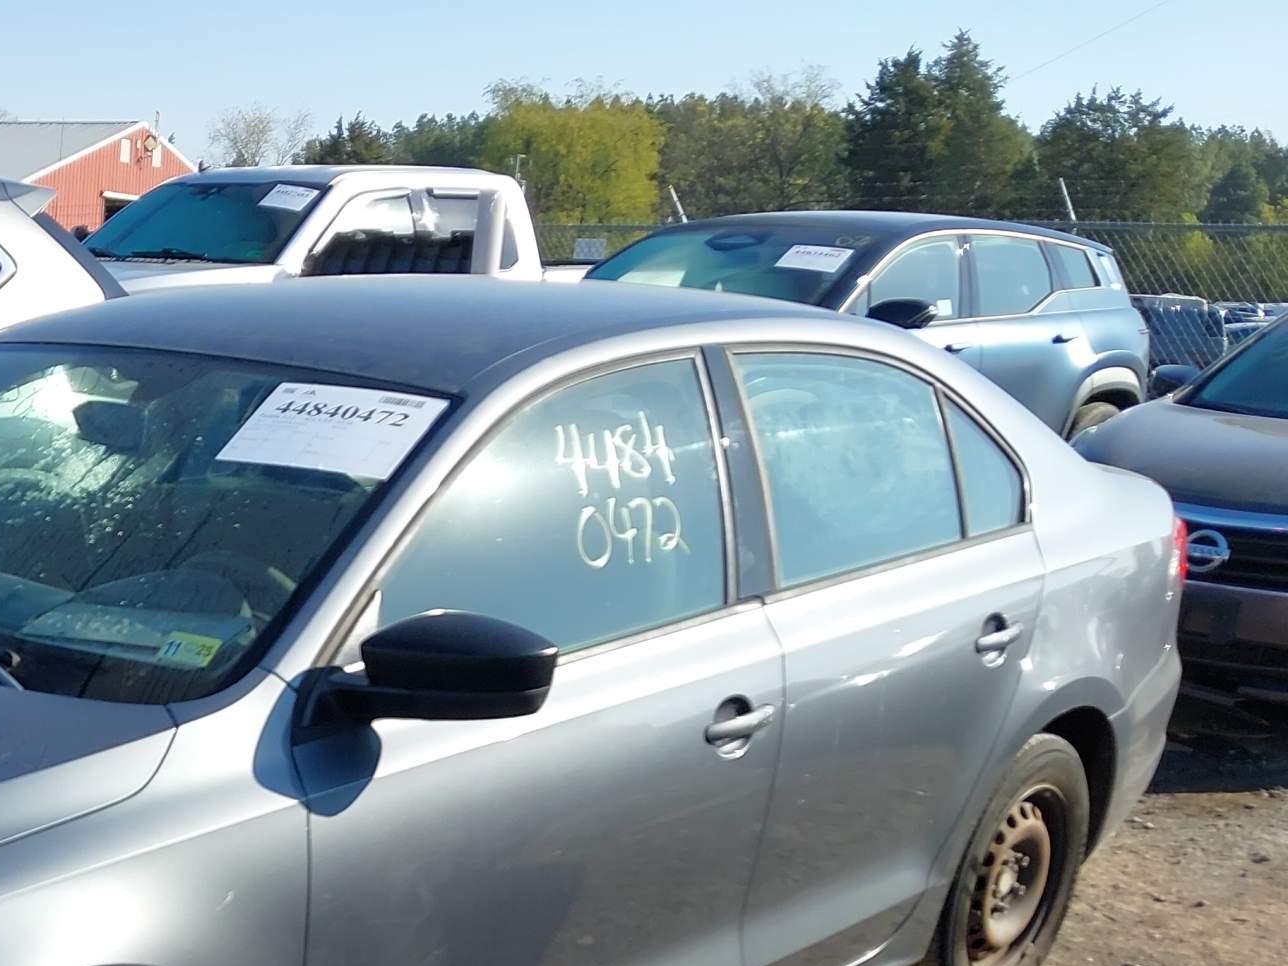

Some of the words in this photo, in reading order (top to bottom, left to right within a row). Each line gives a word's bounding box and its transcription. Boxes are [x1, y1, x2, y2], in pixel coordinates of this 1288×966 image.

[275, 400, 410, 427] 44840472
[554, 411, 676, 496] 4484
[577, 497, 691, 569] 0472
